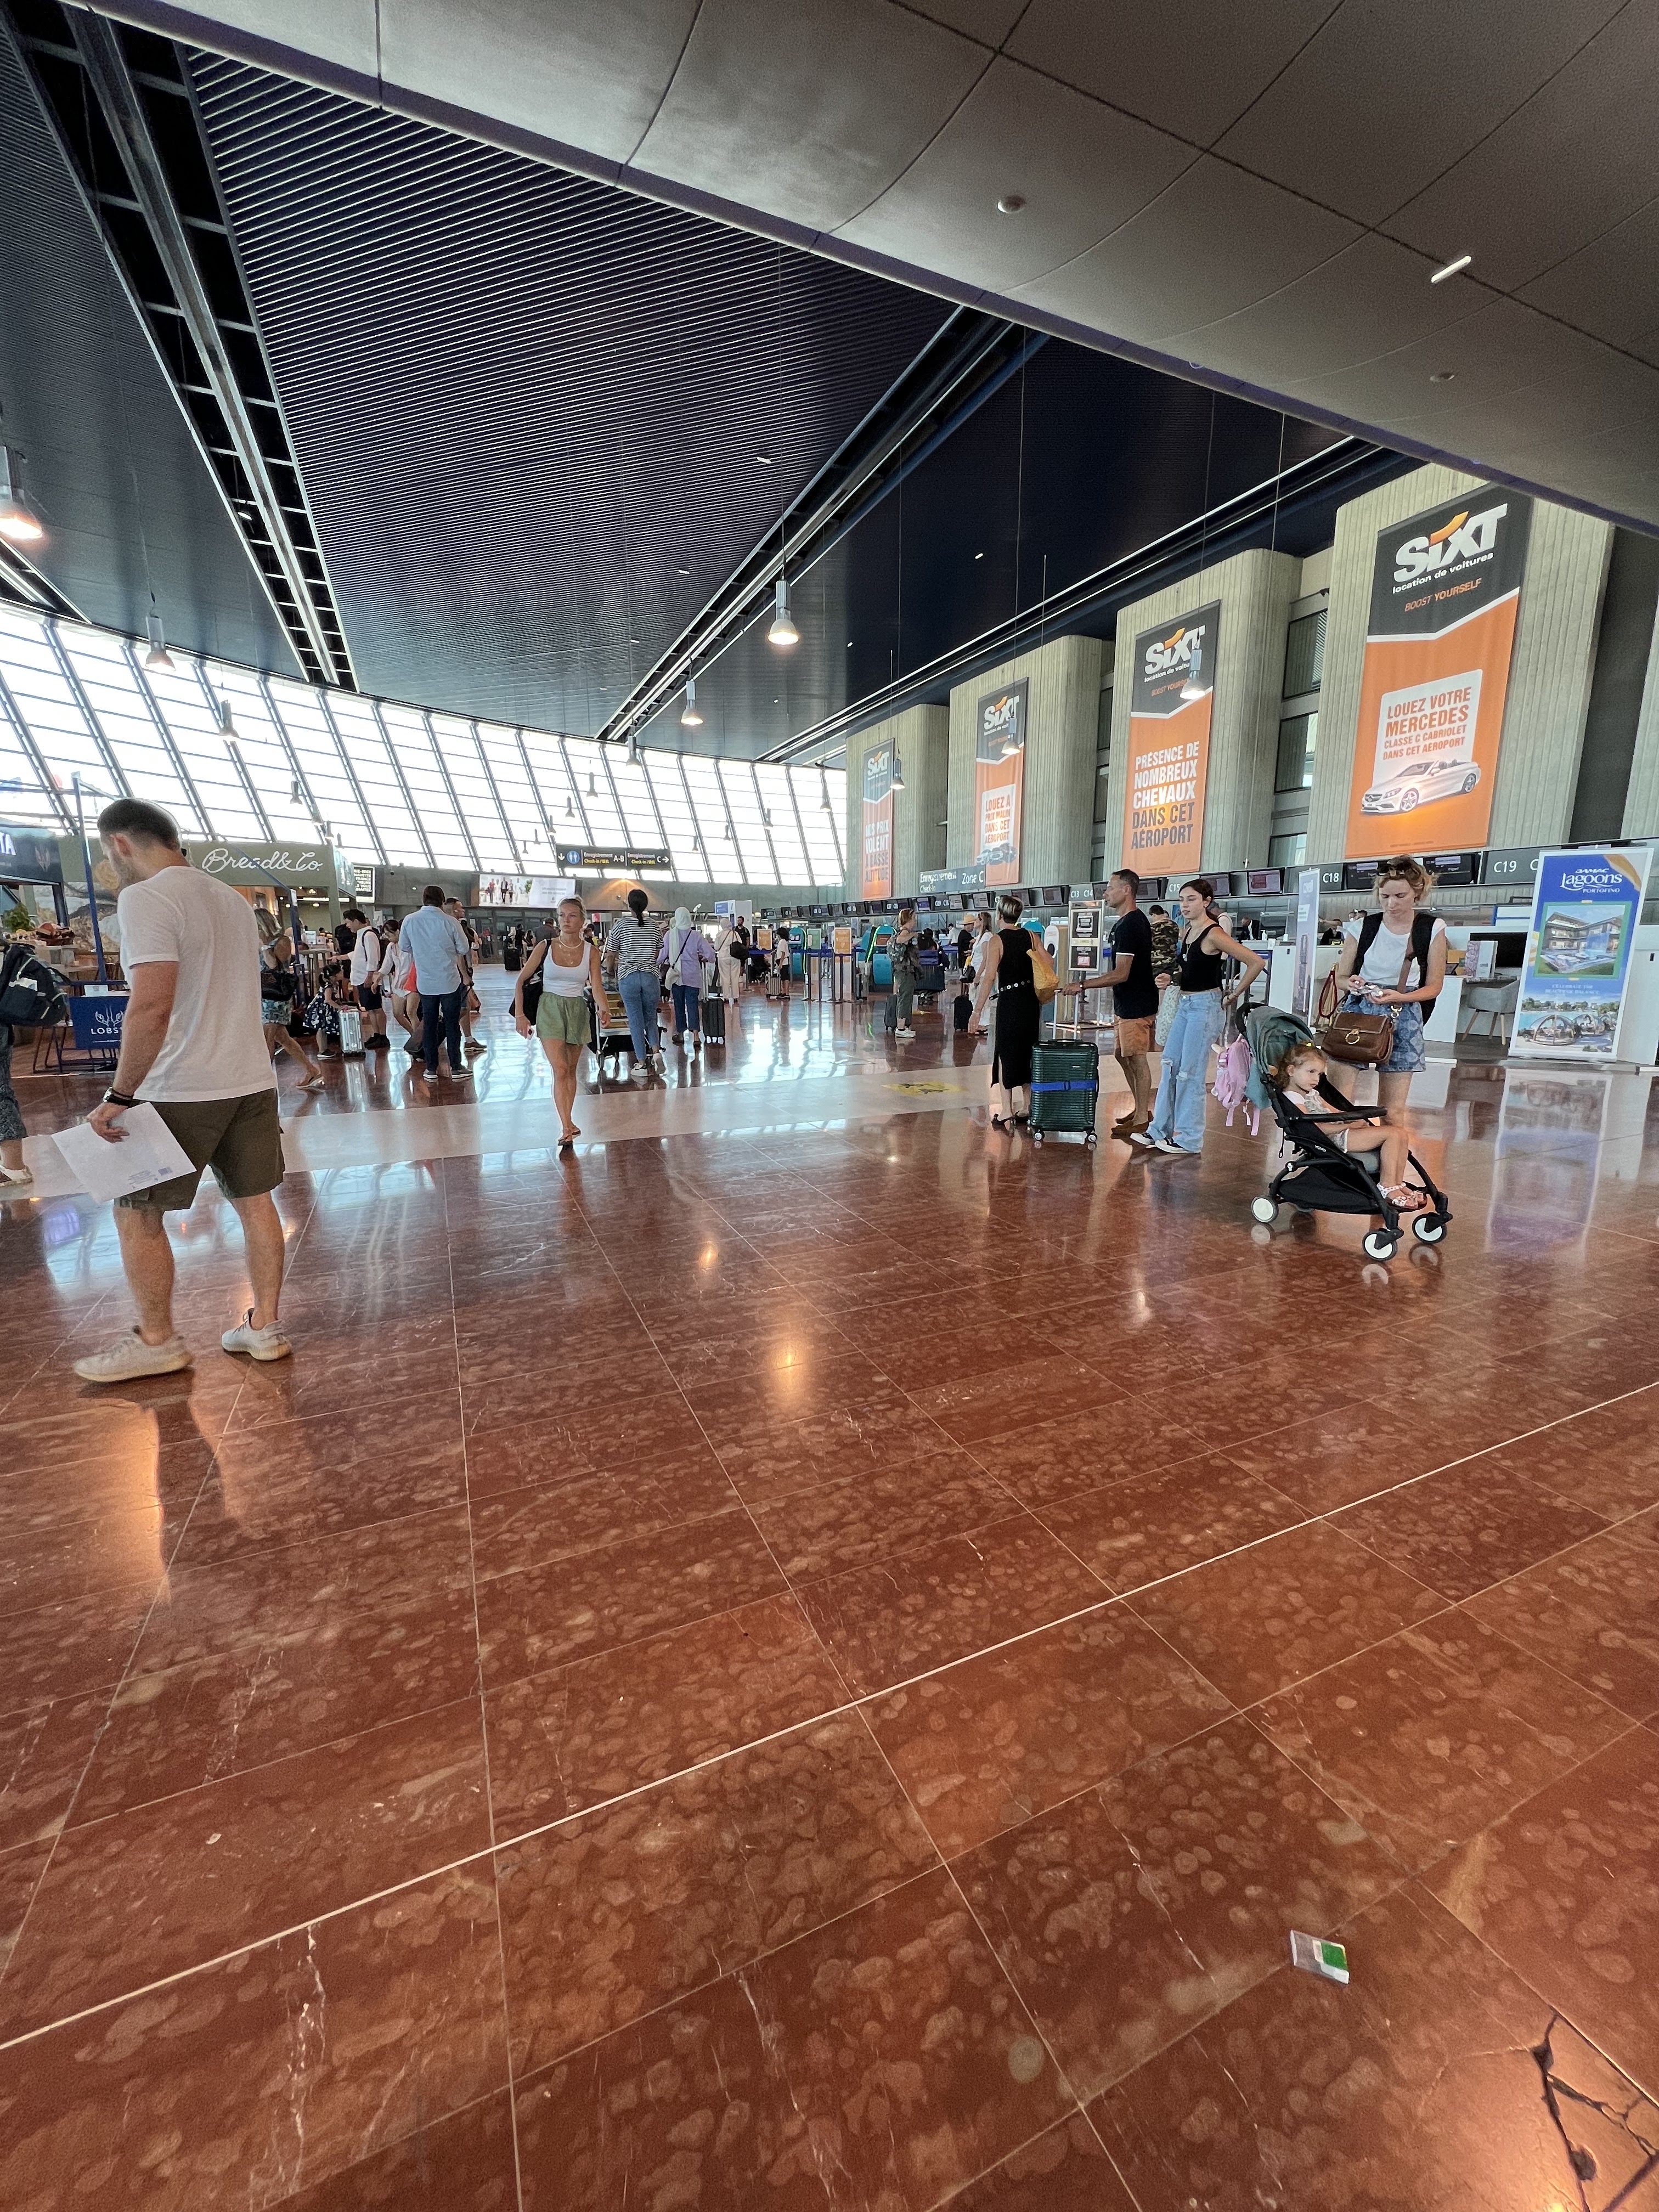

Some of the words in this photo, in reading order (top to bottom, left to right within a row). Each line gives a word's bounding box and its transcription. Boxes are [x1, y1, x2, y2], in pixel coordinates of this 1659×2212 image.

[1392, 574, 1431, 594] location
[1434, 569, 1447, 579] de
[1449, 552, 1493, 573] voitures
[1404, 595, 1432, 612] BOOST
[1434, 578, 1481, 601] YOURSELF
[1144, 671, 1166, 683] location
[1175, 663, 1190, 672] voitu
[1387, 698, 1426, 719] LOUEZ
[1430, 686, 1471, 709] VOTRE
[1385, 704, 1469, 738] MERCEDES
[1384, 736, 1413, 749] CLASSE
[1415, 734, 1420, 742] C
[1423, 724, 1466, 742] CABRIOLET
[1136, 744, 1183, 770] PRÉSENCE
[1186, 741, 1199, 758] DE
[1383, 749, 1403, 760] DANS
[1406, 746, 1420, 755] CET
[1422, 737, 1465, 753] AEROPORT
[1134, 759, 1198, 789] NOMBREUX
[986, 797, 1005, 812] LOUEZ
[1133, 780, 1197, 809] CHEVAUX
[985, 812, 995, 821] PRIX
[996, 809, 1010, 819] MALIN
[1132, 807, 1165, 829] DANS
[1170, 802, 1195, 823] CET
[877, 819, 889, 834] PRIX
[985, 822, 998, 833] DANS
[1000, 819, 1009, 830] CET
[1131, 823, 1193, 849] AÉROPORT
[866, 834, 889, 854] VOLENT
[865, 867, 888, 883] ALTITUDE
[1493, 860, 1517, 873] C19
[920, 871, 957, 884] Enregistrement
[962, 873, 977, 885] Zone
[979, 871, 984, 883] C
[1169, 883, 1181, 892] C15
[1322, 872, 1339, 883] C18
[920, 884, 936, 893] Check-in
[1071, 890, 1079, 898] C13
[1084, 889, 1093, 898] C14
